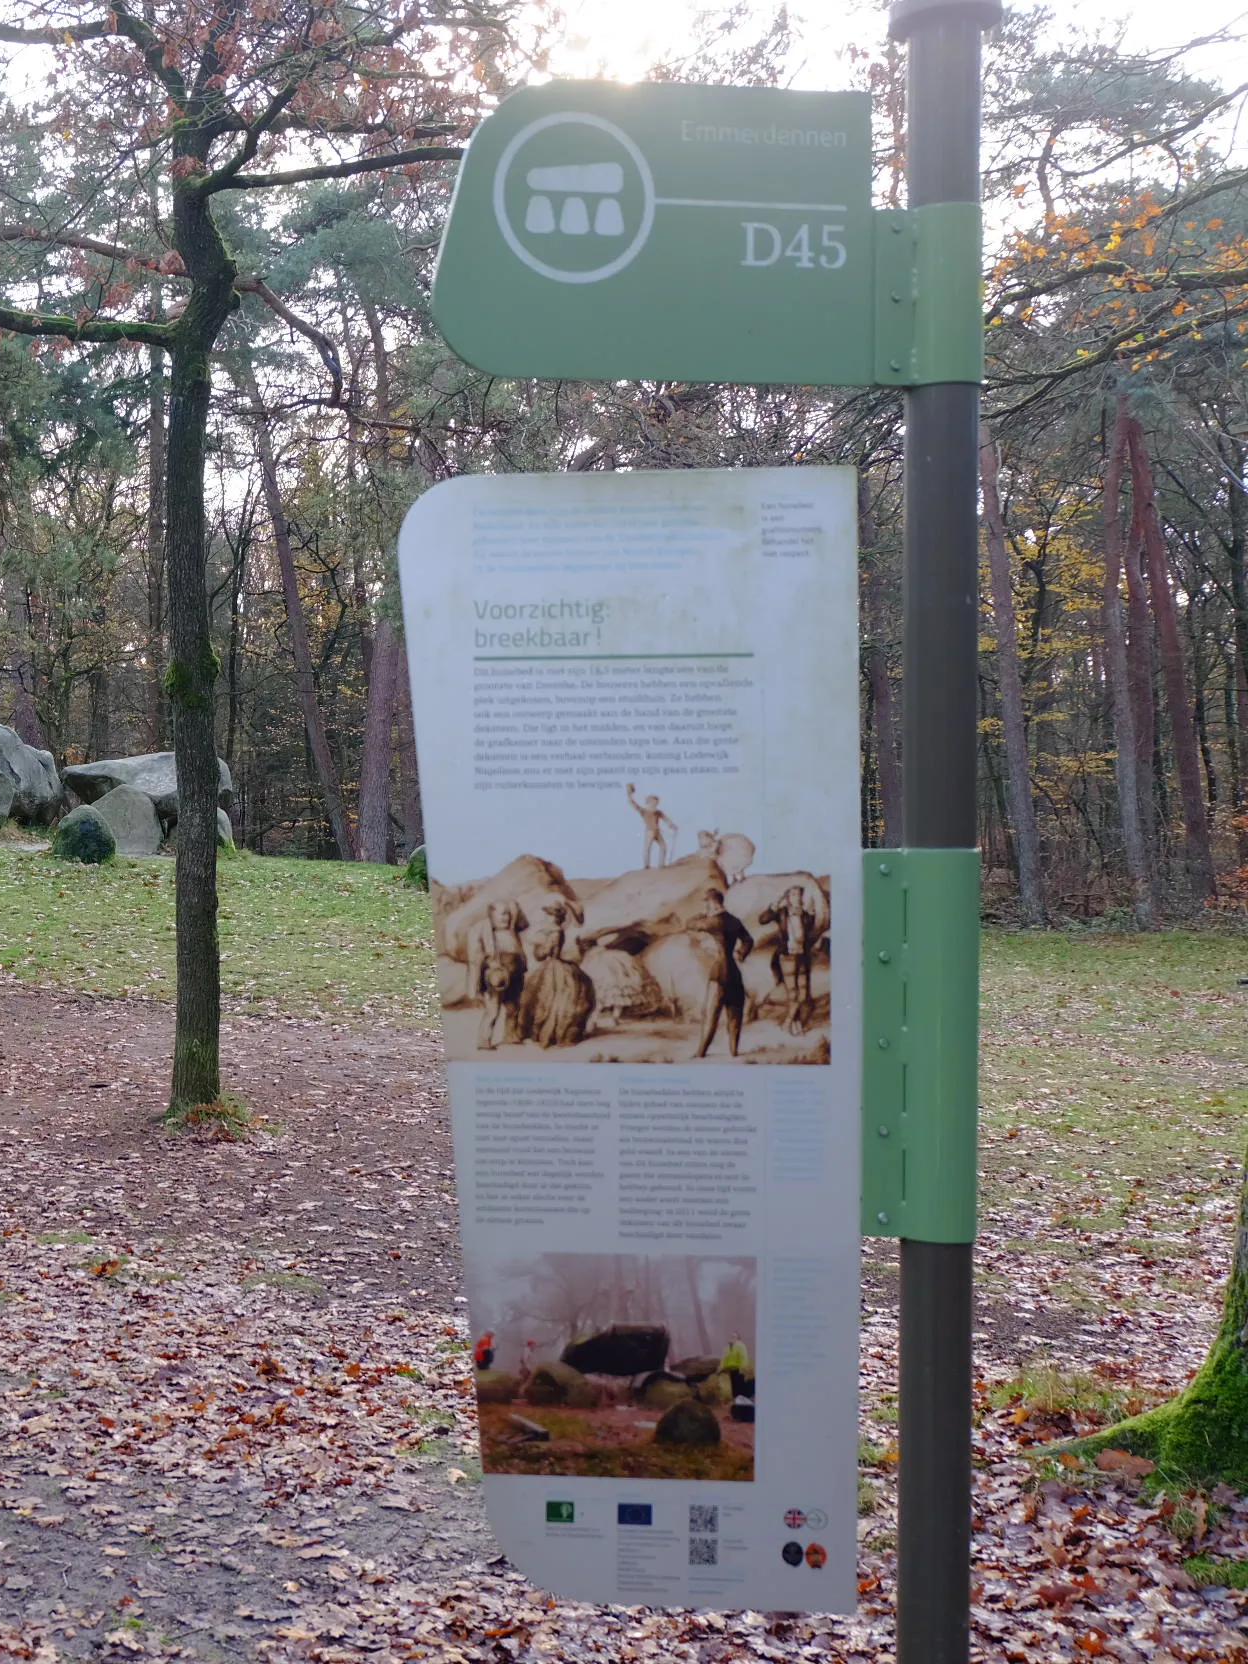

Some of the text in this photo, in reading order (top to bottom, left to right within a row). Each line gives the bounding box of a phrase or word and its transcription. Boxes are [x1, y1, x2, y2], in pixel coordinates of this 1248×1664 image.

[681, 119, 846, 148] Emmerdennen
[740, 222, 846, 269] D45
[473, 599, 610, 624] Voorzichtig:
[474, 626, 602, 649] breekbaar!
